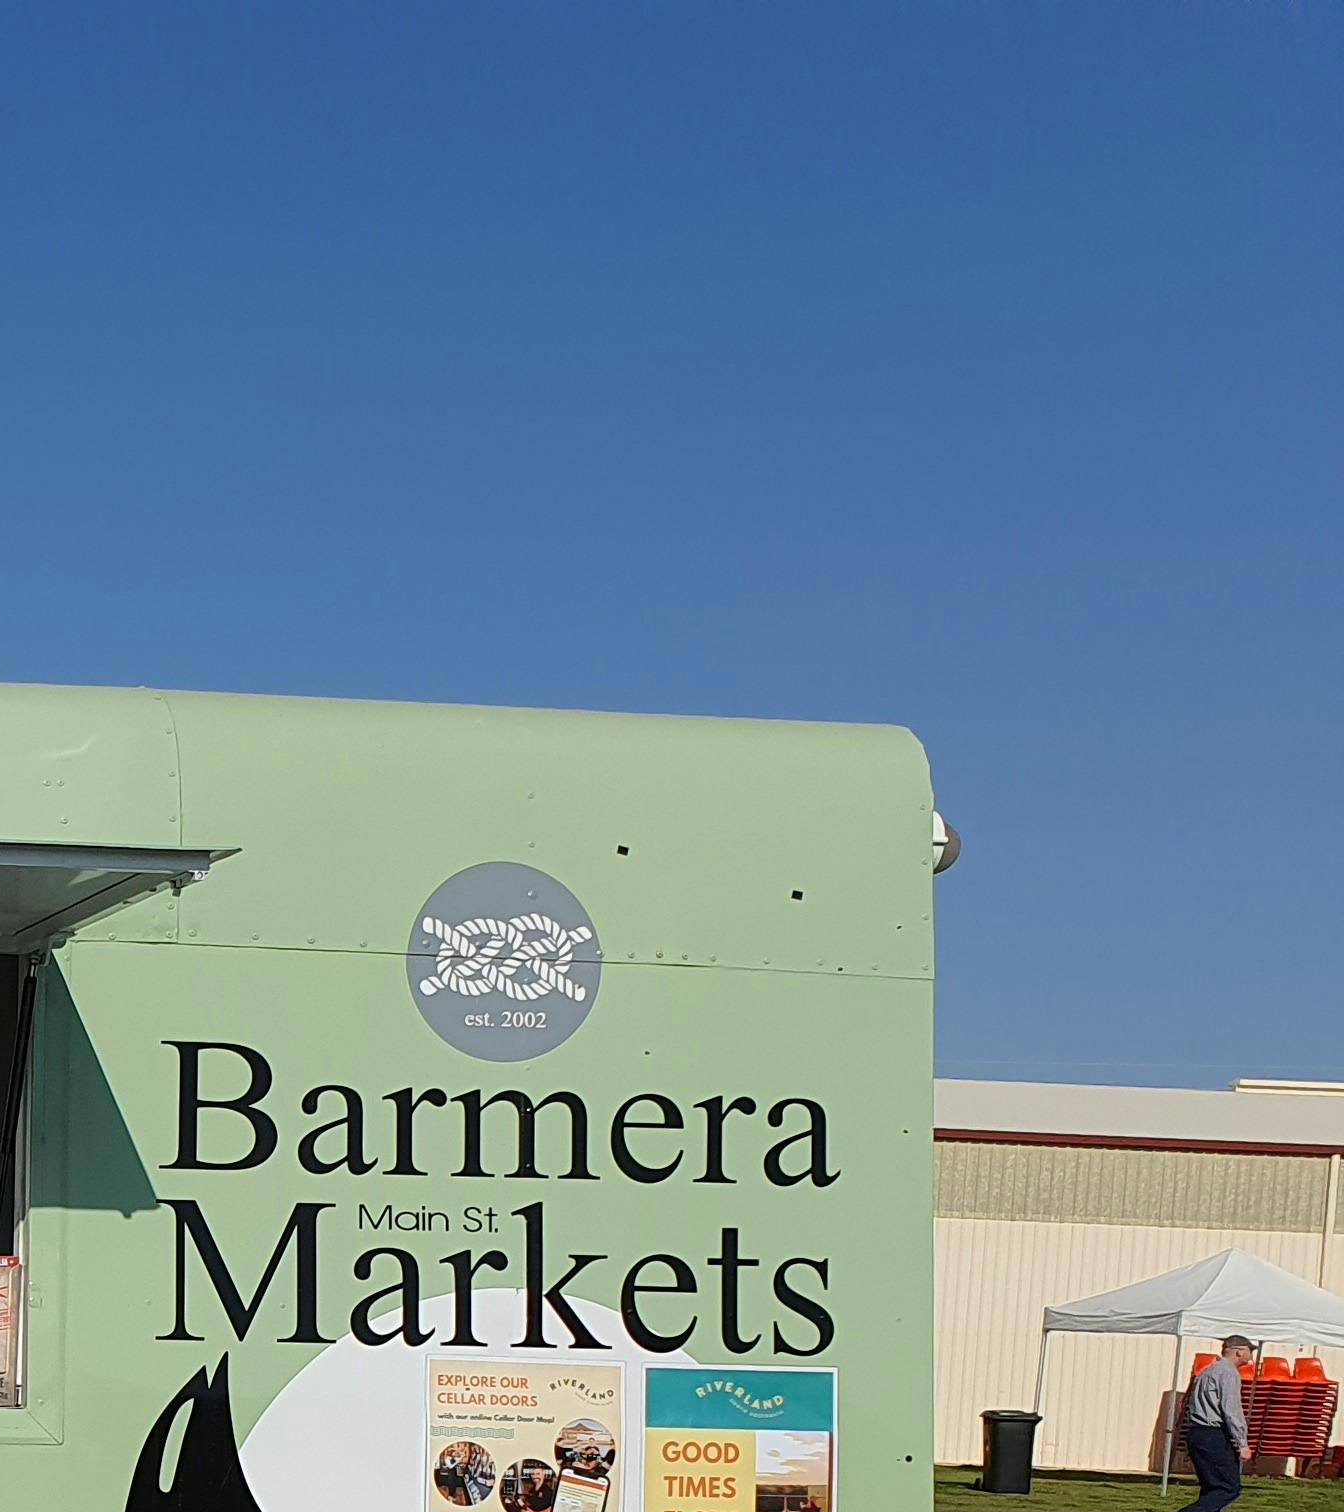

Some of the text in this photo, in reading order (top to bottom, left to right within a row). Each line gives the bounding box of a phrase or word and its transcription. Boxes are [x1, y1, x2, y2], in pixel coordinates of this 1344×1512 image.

[464, 1011, 548, 1030] est. 2002
[159, 1040, 841, 1188] Barmera
[357, 1204, 500, 1234] Main St.
[155, 1200, 836, 1357] Markets
[437, 1375, 529, 1389] EXPLORE OUR
[549, 1378, 614, 1401] RIVERLAND
[437, 1392, 538, 1407] CELLAR DOORS
[695, 1381, 784, 1409] RIVERLAND
[661, 1441, 740, 1465] GOOD
[663, 1476, 737, 1498] TIMES
